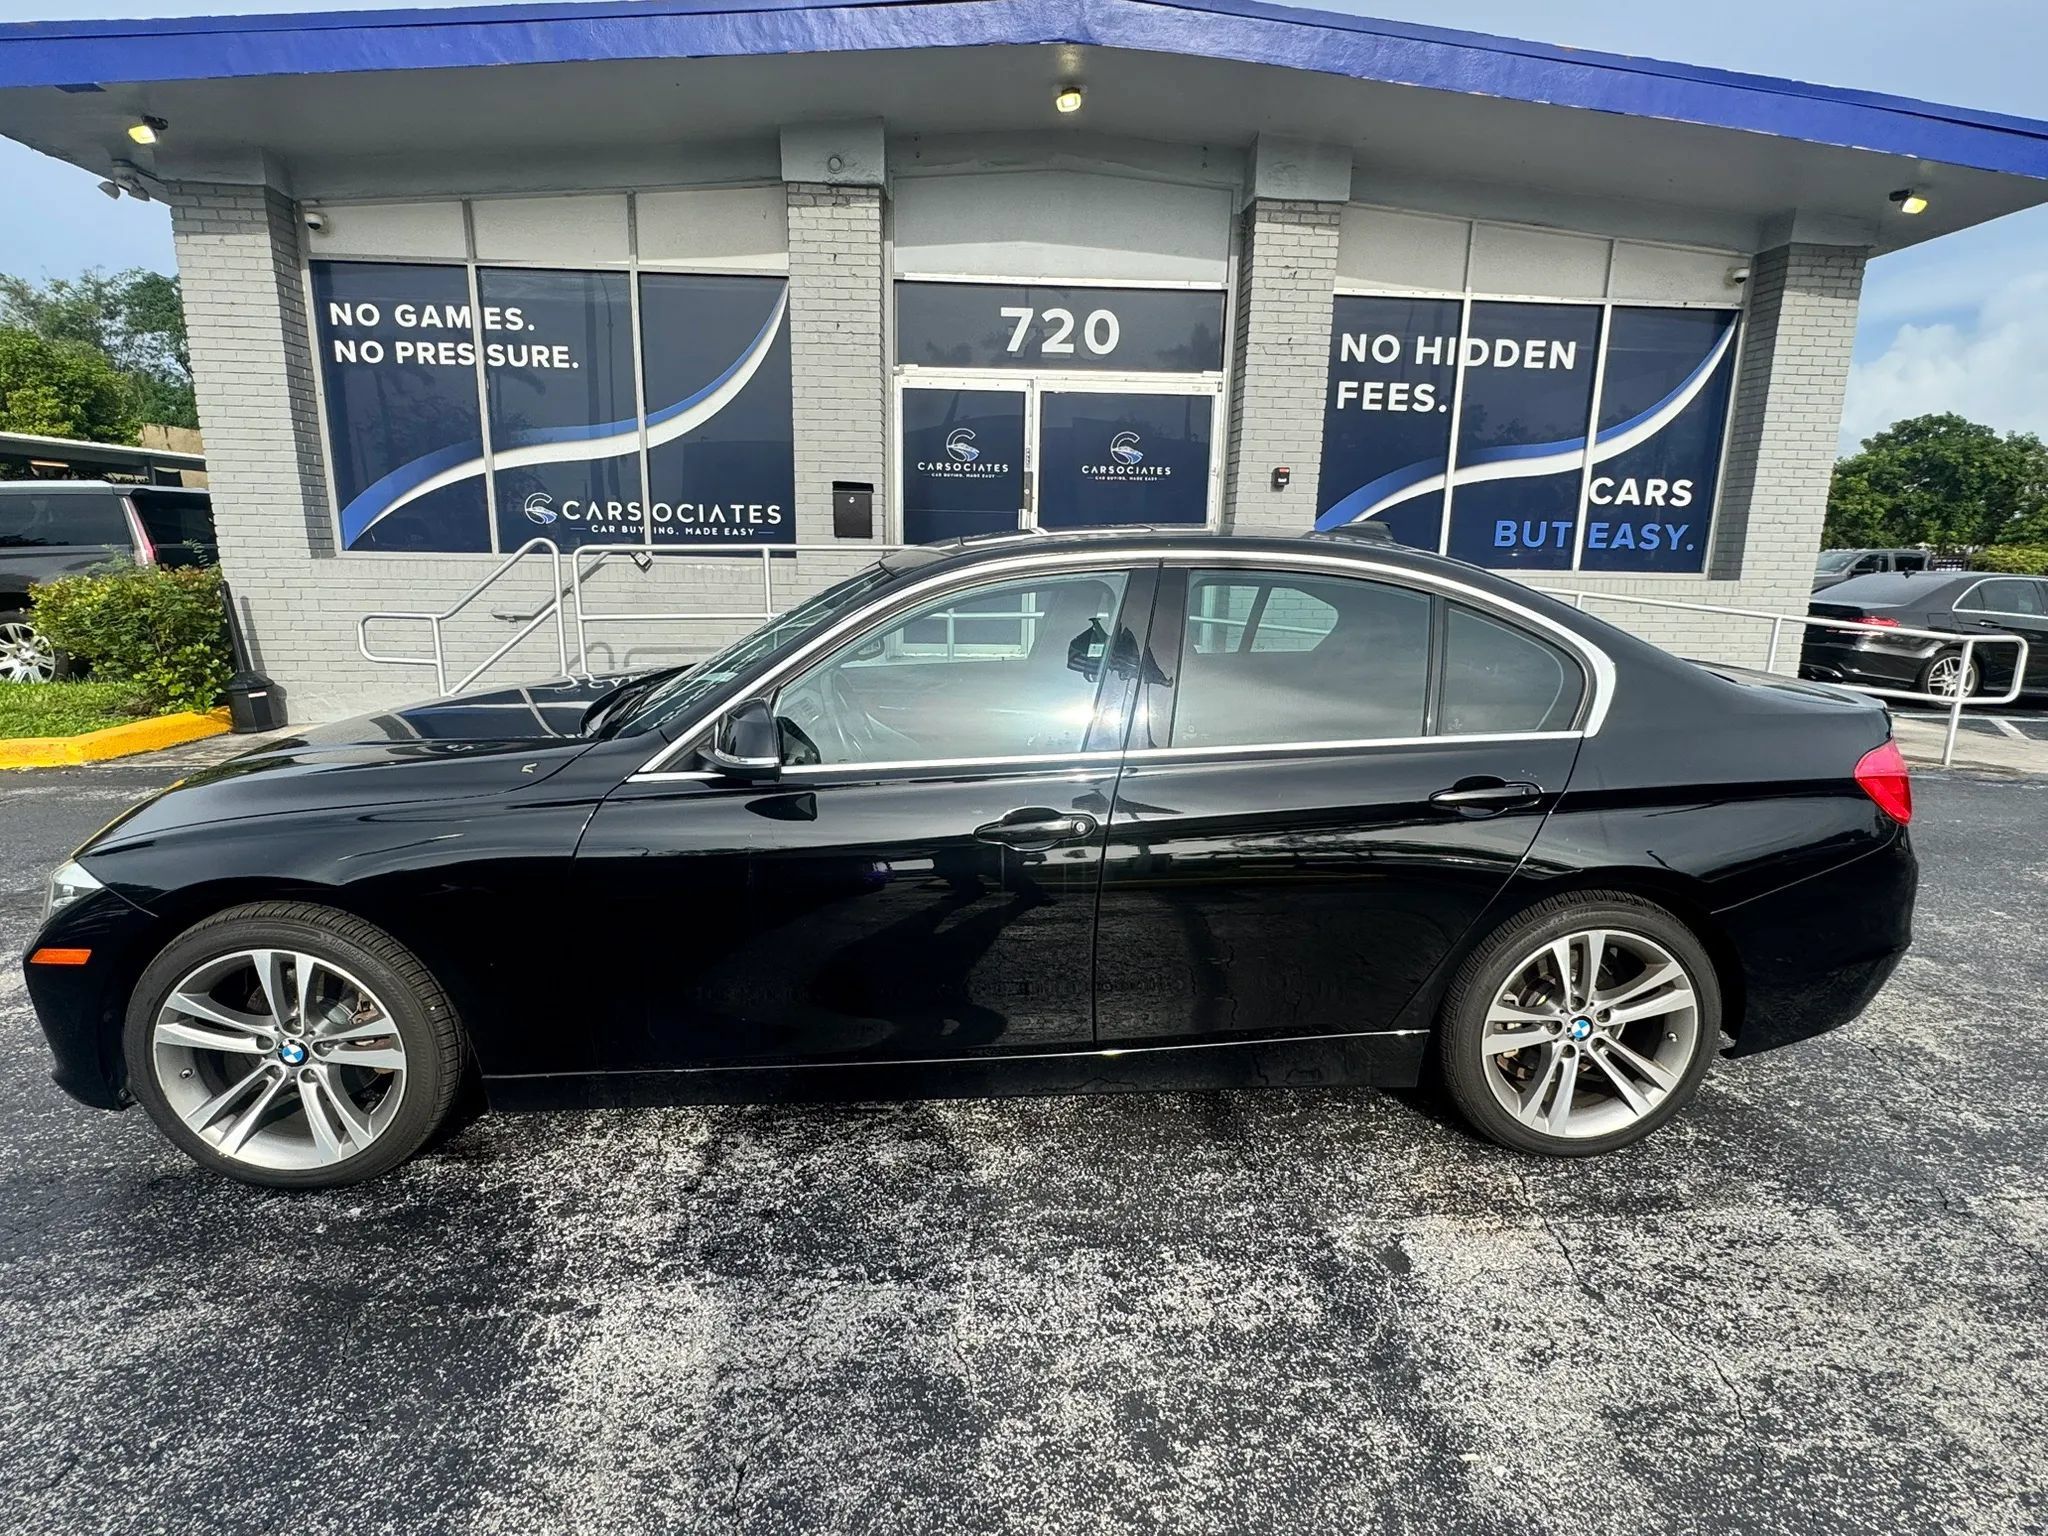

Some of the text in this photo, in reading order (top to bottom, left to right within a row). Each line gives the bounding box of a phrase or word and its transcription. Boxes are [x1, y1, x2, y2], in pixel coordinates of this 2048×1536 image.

[330, 303, 535, 331] NO GAMES.
[1000, 307, 1120, 355] 720
[335, 340, 579, 369] NO PRESSURE.
[1341, 333, 1577, 371] NO HIDDEN
[1337, 381, 1447, 413] FEES.
[917, 461, 1009, 473] CARSOCIATES
[1081, 465, 1172, 475] CARSOCIATES
[1588, 478, 1694, 507] CARS
[562, 500, 782, 524] CARSOCIATES
[591, 525, 756, 536] CAR BUYING. MADE EASY
[1494, 521, 1695, 551] BUT EASY.
